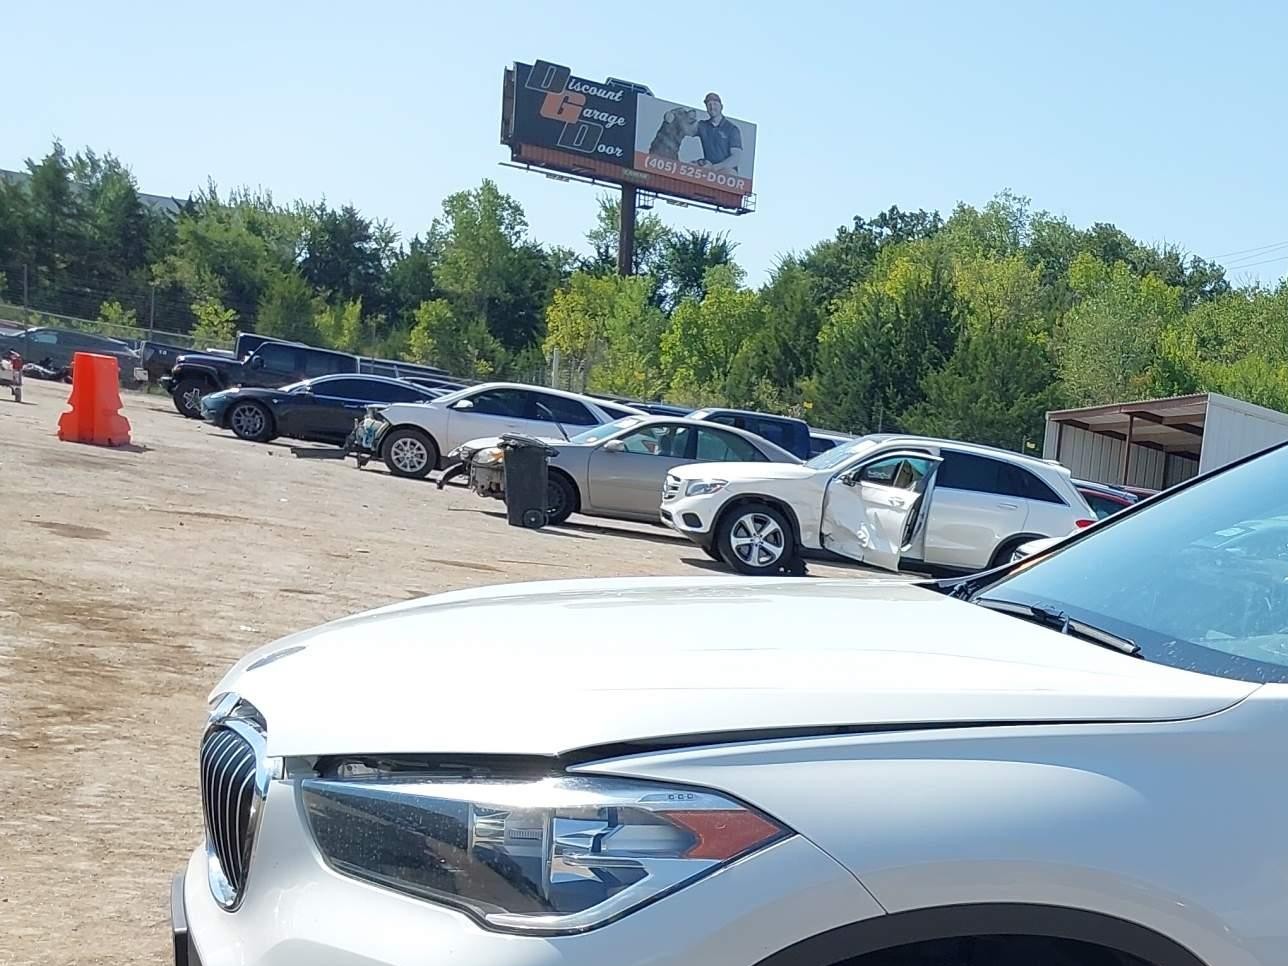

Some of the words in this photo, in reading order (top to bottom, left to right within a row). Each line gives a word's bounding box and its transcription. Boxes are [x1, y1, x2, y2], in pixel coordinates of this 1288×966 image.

[525, 59, 624, 102] Discount
[540, 91, 626, 129] Garage
[557, 120, 624, 158] Door
[644, 156, 677, 174] (405)
[679, 164, 745, 191] 525-DOOR
